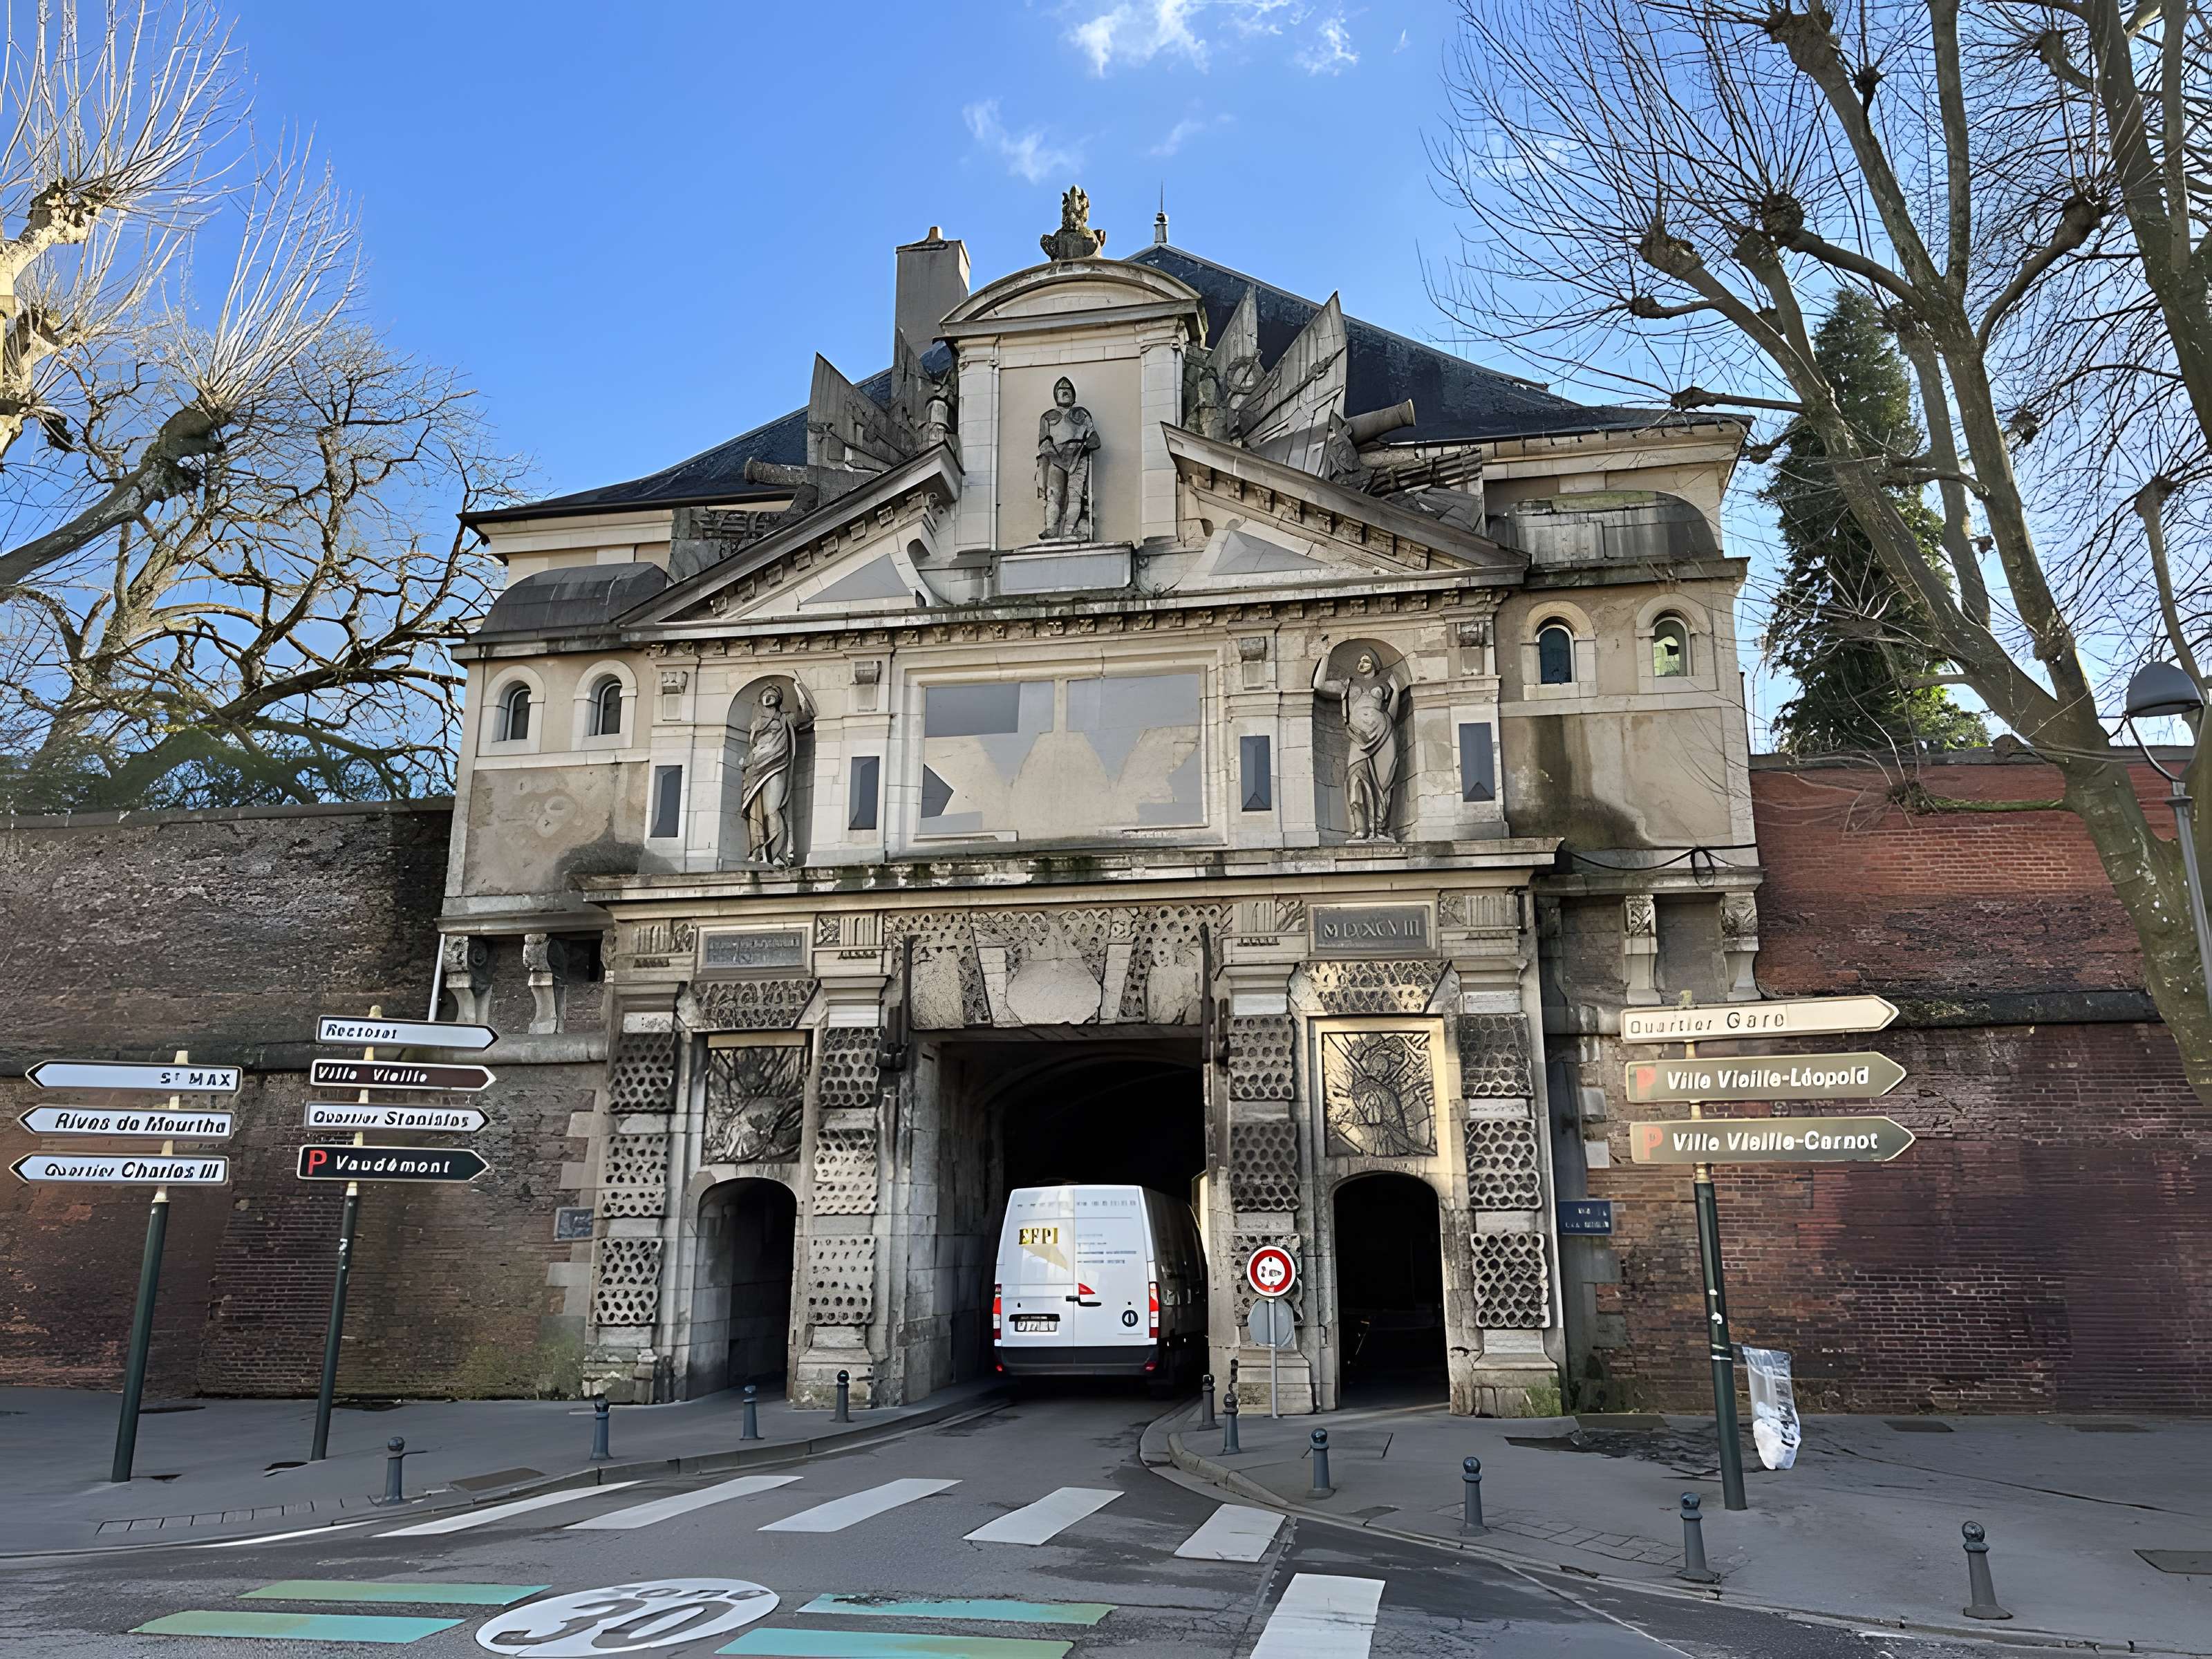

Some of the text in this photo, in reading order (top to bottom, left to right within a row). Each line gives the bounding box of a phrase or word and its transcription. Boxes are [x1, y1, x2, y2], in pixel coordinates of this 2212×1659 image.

[1631, 1011, 1784, 1034] Quartier Gare
[189, 1072, 230, 1087] MAX
[318, 1066, 427, 1082] Ville Vieille
[1636, 1065, 1656, 1100] P
[1667, 1070, 1711, 1089] Ville
[116, 1115, 140, 1131] de
[144, 1116, 226, 1133] Meurthe
[384, 1111, 469, 1127] Stanislas
[1644, 1126, 1663, 1160] P
[1673, 1132, 1720, 1151] Ville
[122, 1161, 195, 1179] Charles
[199, 1163, 219, 1179] III
[307, 1149, 328, 1175] P
[489, 1597, 738, 1649] 30
